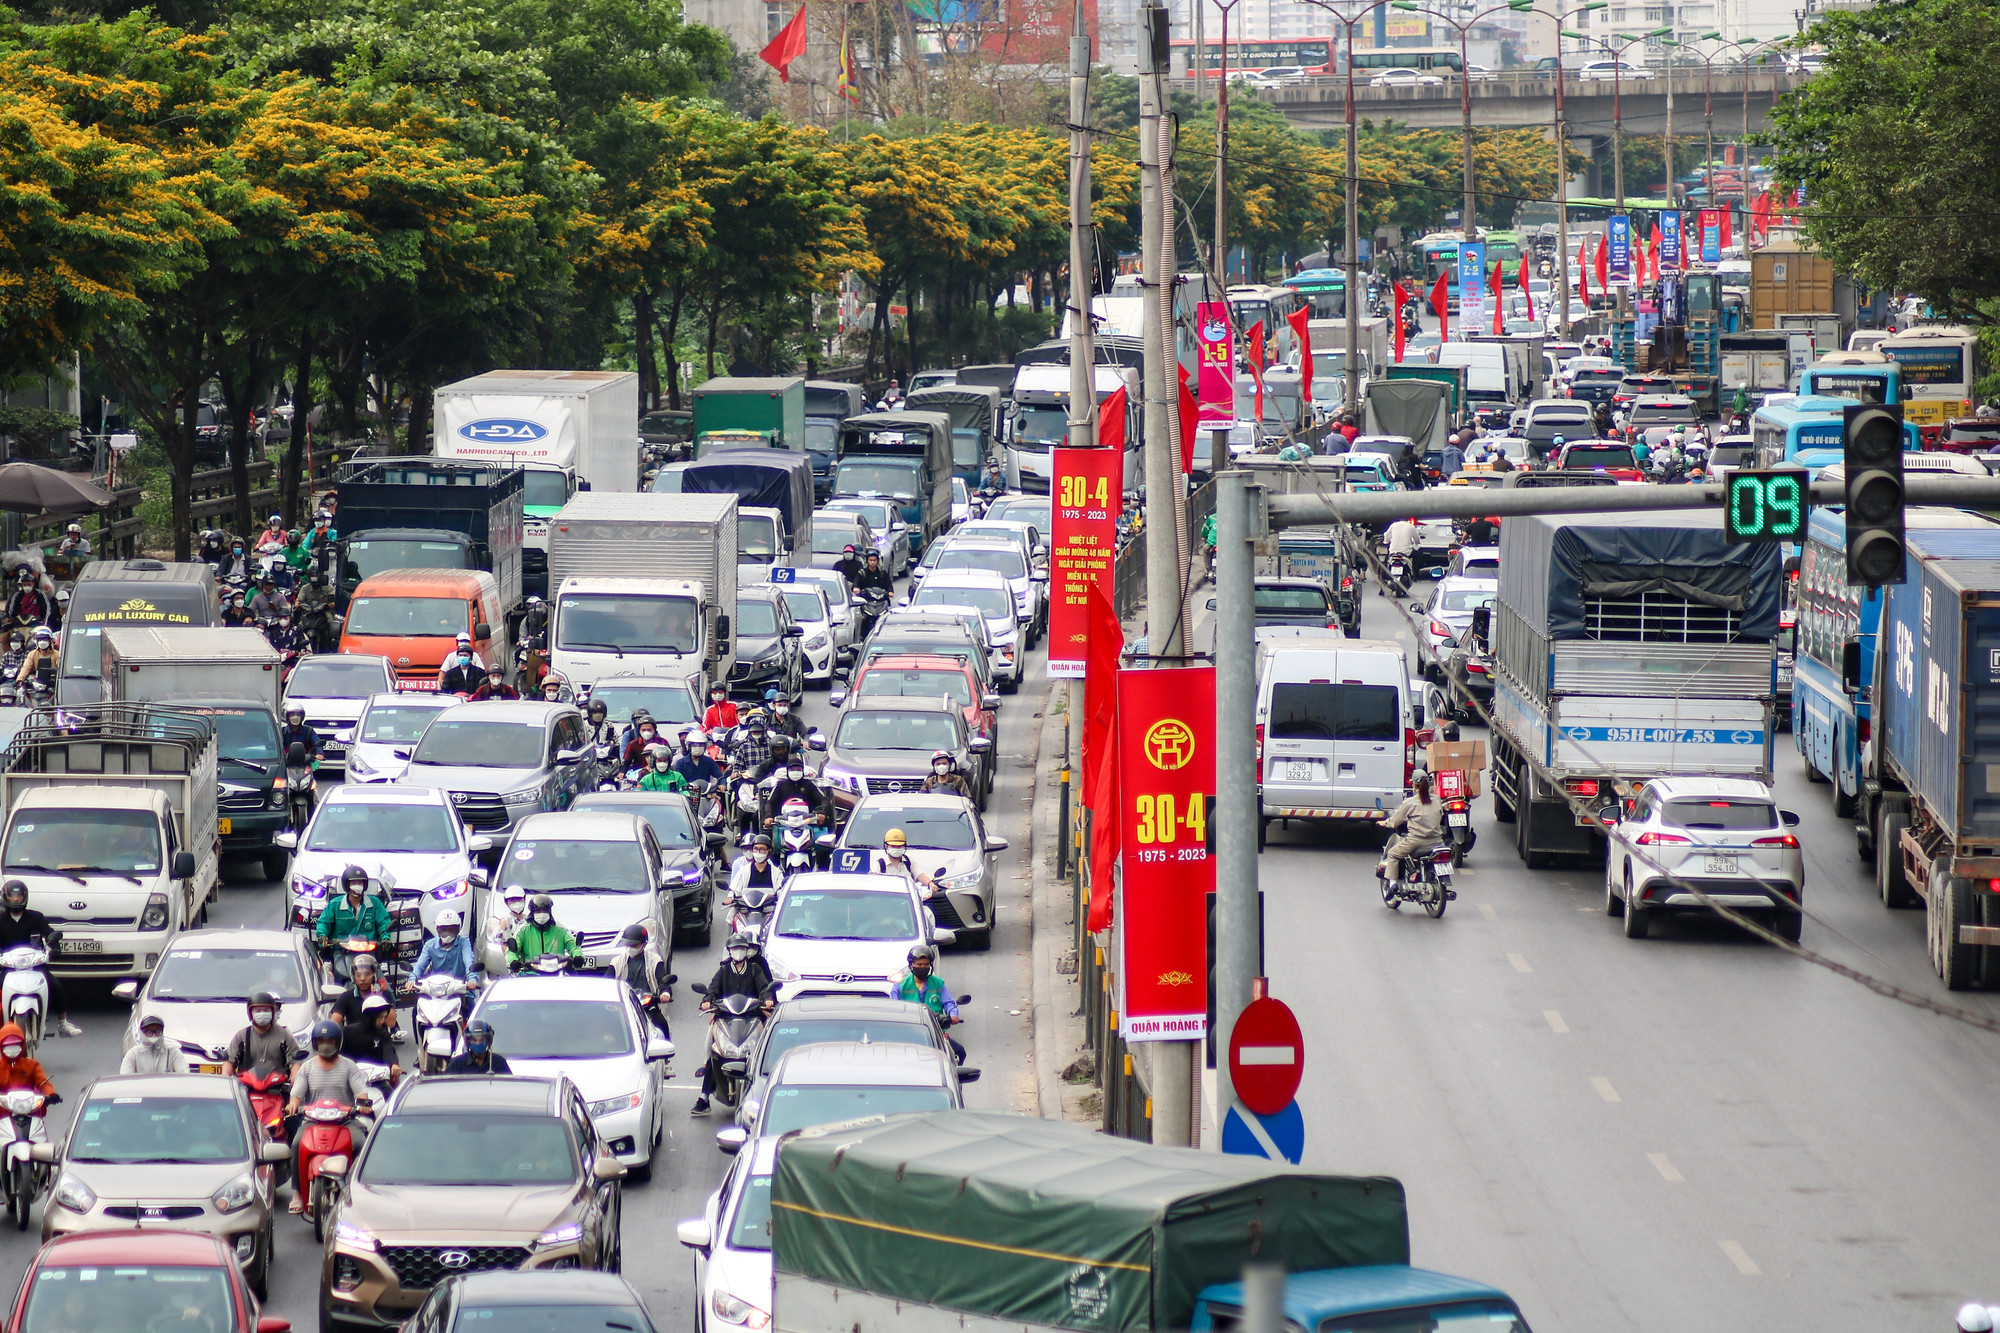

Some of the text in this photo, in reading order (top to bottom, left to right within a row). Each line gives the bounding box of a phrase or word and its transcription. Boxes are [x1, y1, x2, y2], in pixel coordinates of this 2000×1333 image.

[1060, 476, 1108, 508] 30-4
[1731, 476, 1800, 535] 09
[1061, 510, 1080, 519] 1975
[1087, 511, 1107, 520] 2023
[1083, 572, 1097, 582] NM,
[85, 612, 190, 624] VAN HA LUXURY CAR
[1051, 662, 1070, 673] QUẬN
[399, 680, 437, 689] Taxi 123
[1607, 728, 1715, 743] 95H-007.58
[1292, 763, 1306, 771] 29D
[1136, 792, 1206, 844] 30-4
[1137, 850, 1166, 862] 1975
[1178, 848, 1206, 861] 2023
[841, 852, 862, 872] G7
[1708, 864, 1734, 872] 554.10
[1131, 1020, 1160, 1035] QUẬN
[1163, 1018, 1198, 1031] HOÀNG
